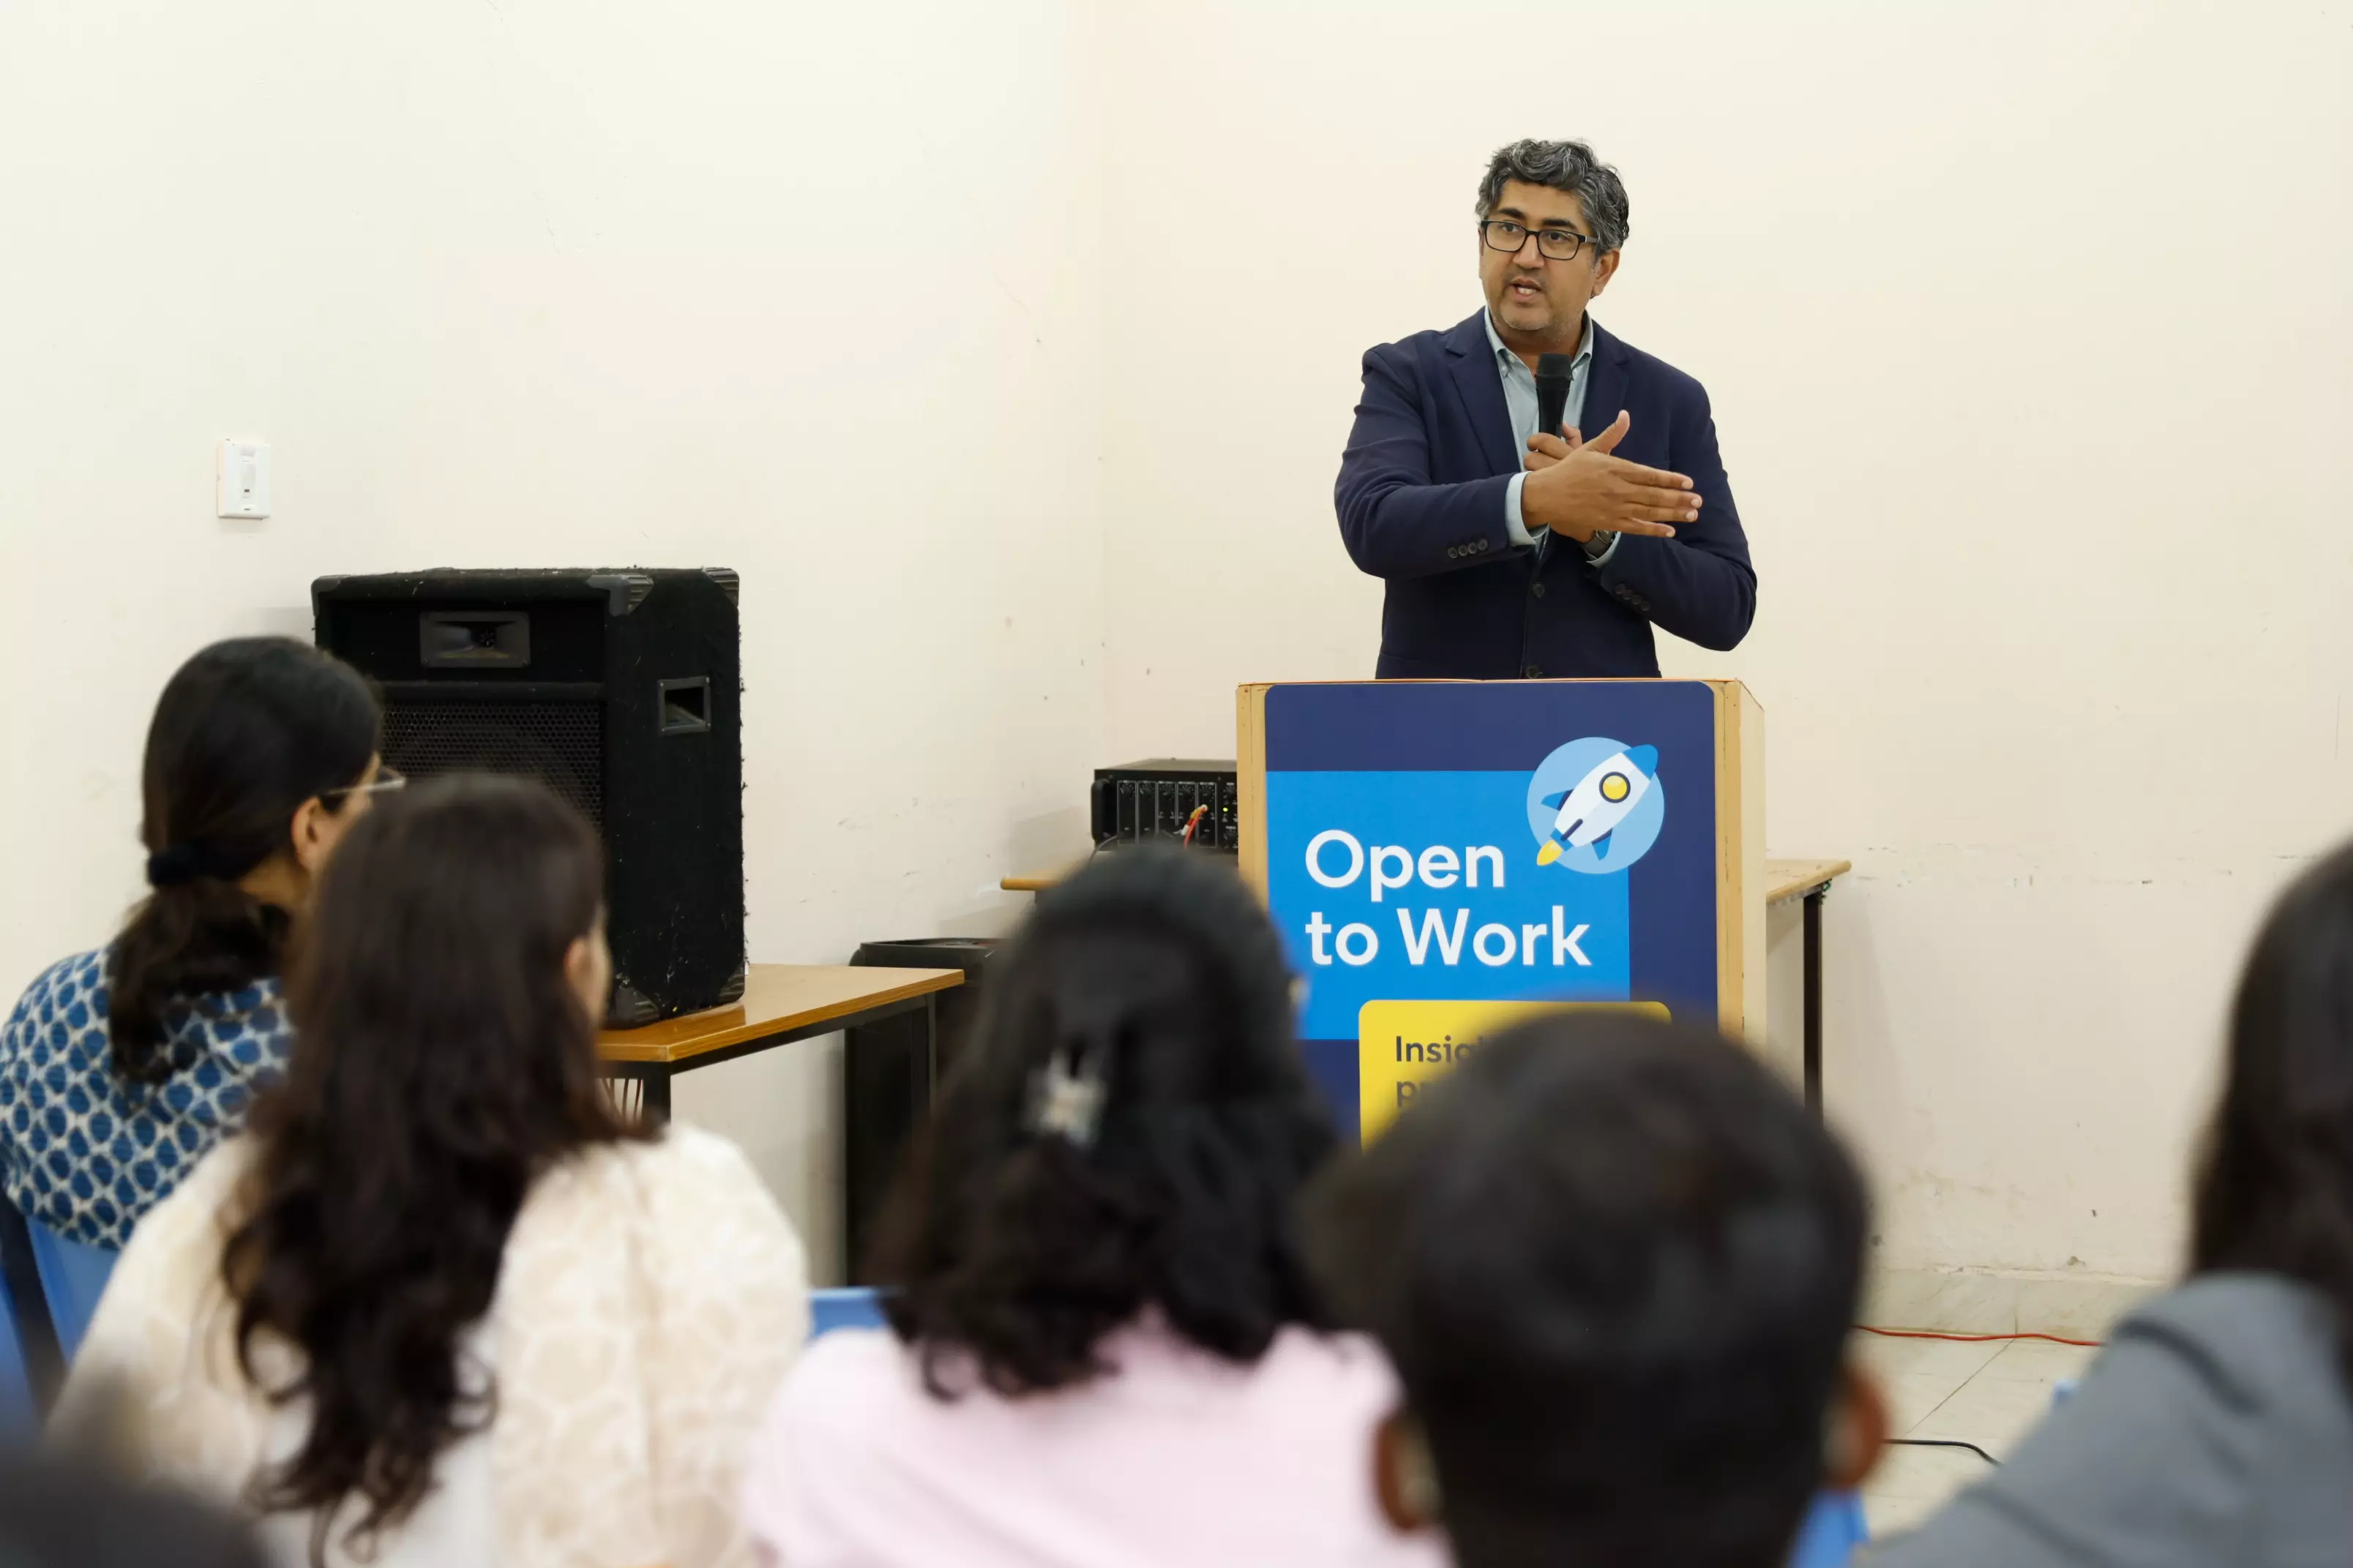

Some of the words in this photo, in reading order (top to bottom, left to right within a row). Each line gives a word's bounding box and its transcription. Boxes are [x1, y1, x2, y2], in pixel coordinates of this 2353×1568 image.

[1305, 829, 1505, 902] Open
[1305, 911, 1379, 967] to
[1396, 904, 1592, 967] Work
